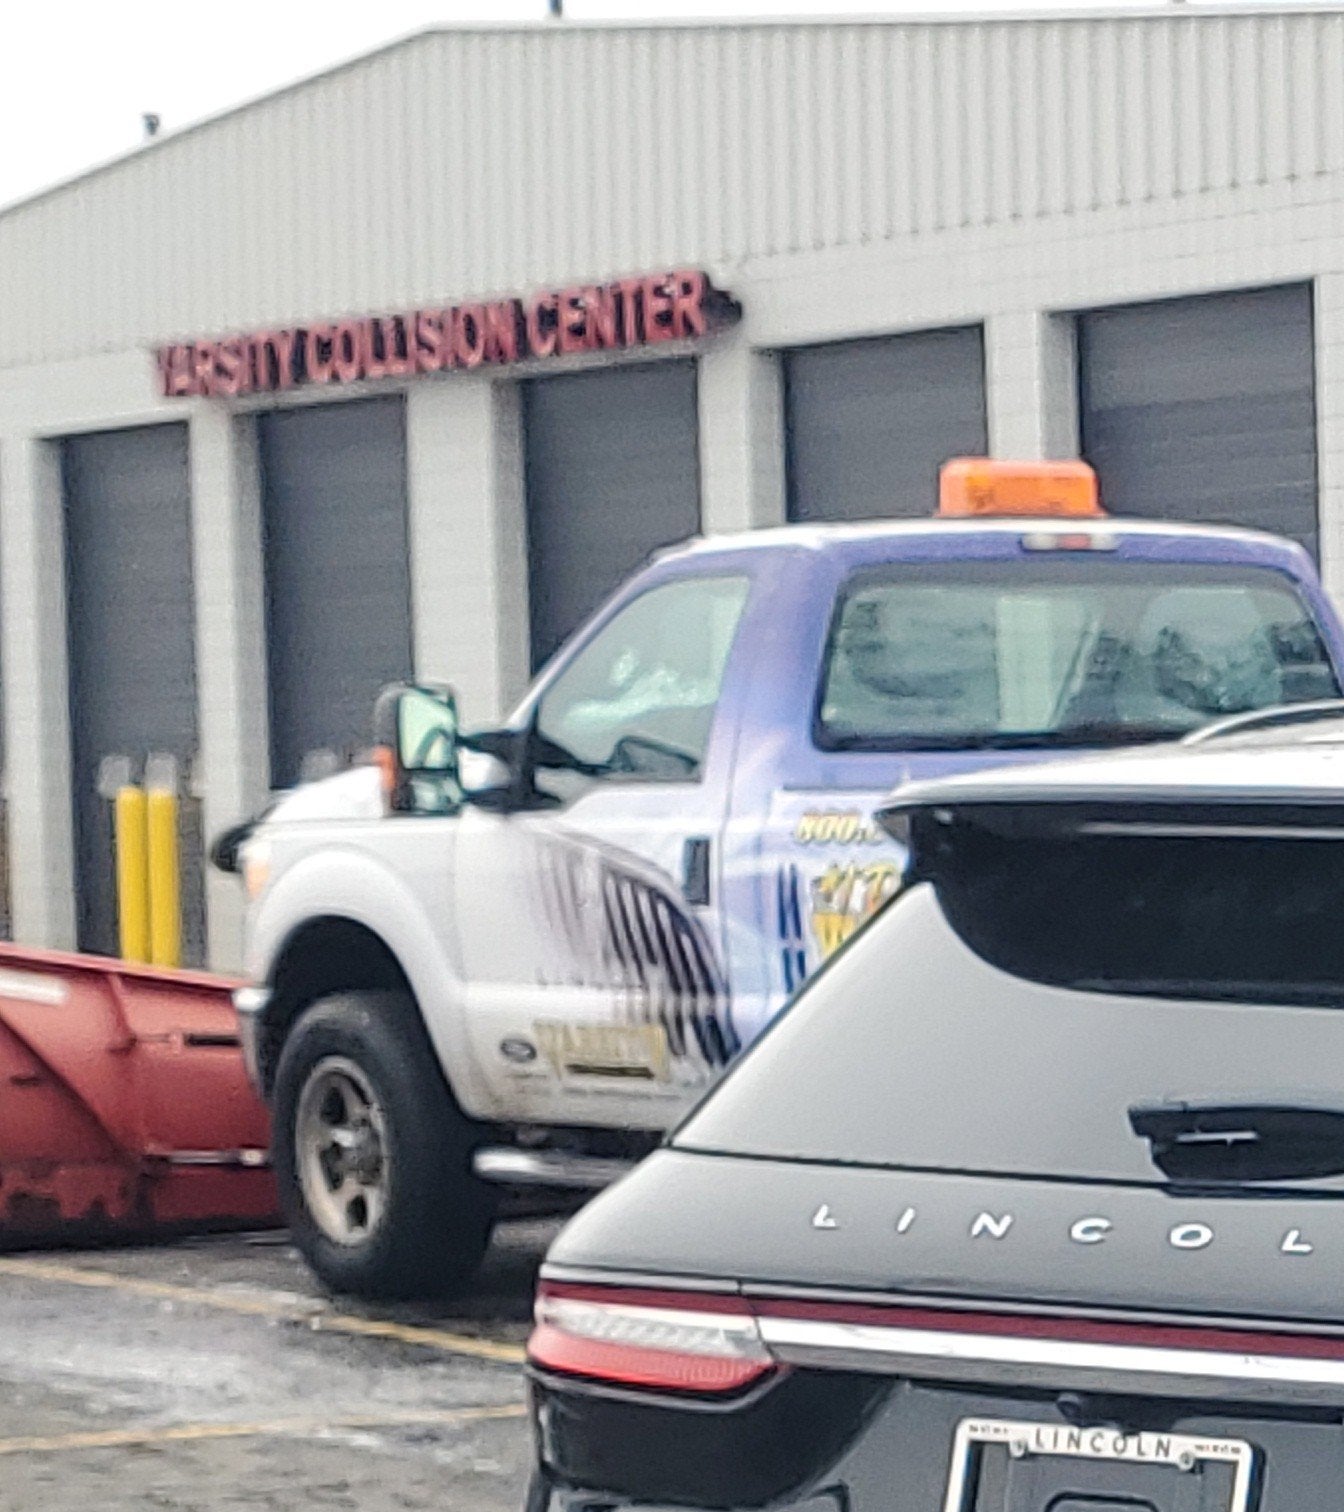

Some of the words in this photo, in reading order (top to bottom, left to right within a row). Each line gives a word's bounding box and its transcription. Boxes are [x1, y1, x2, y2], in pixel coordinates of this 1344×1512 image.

[307, 302, 517, 383] COLLISION
[527, 269, 708, 357] CENTER
[1035, 1428, 1172, 1459] LINCOLN
